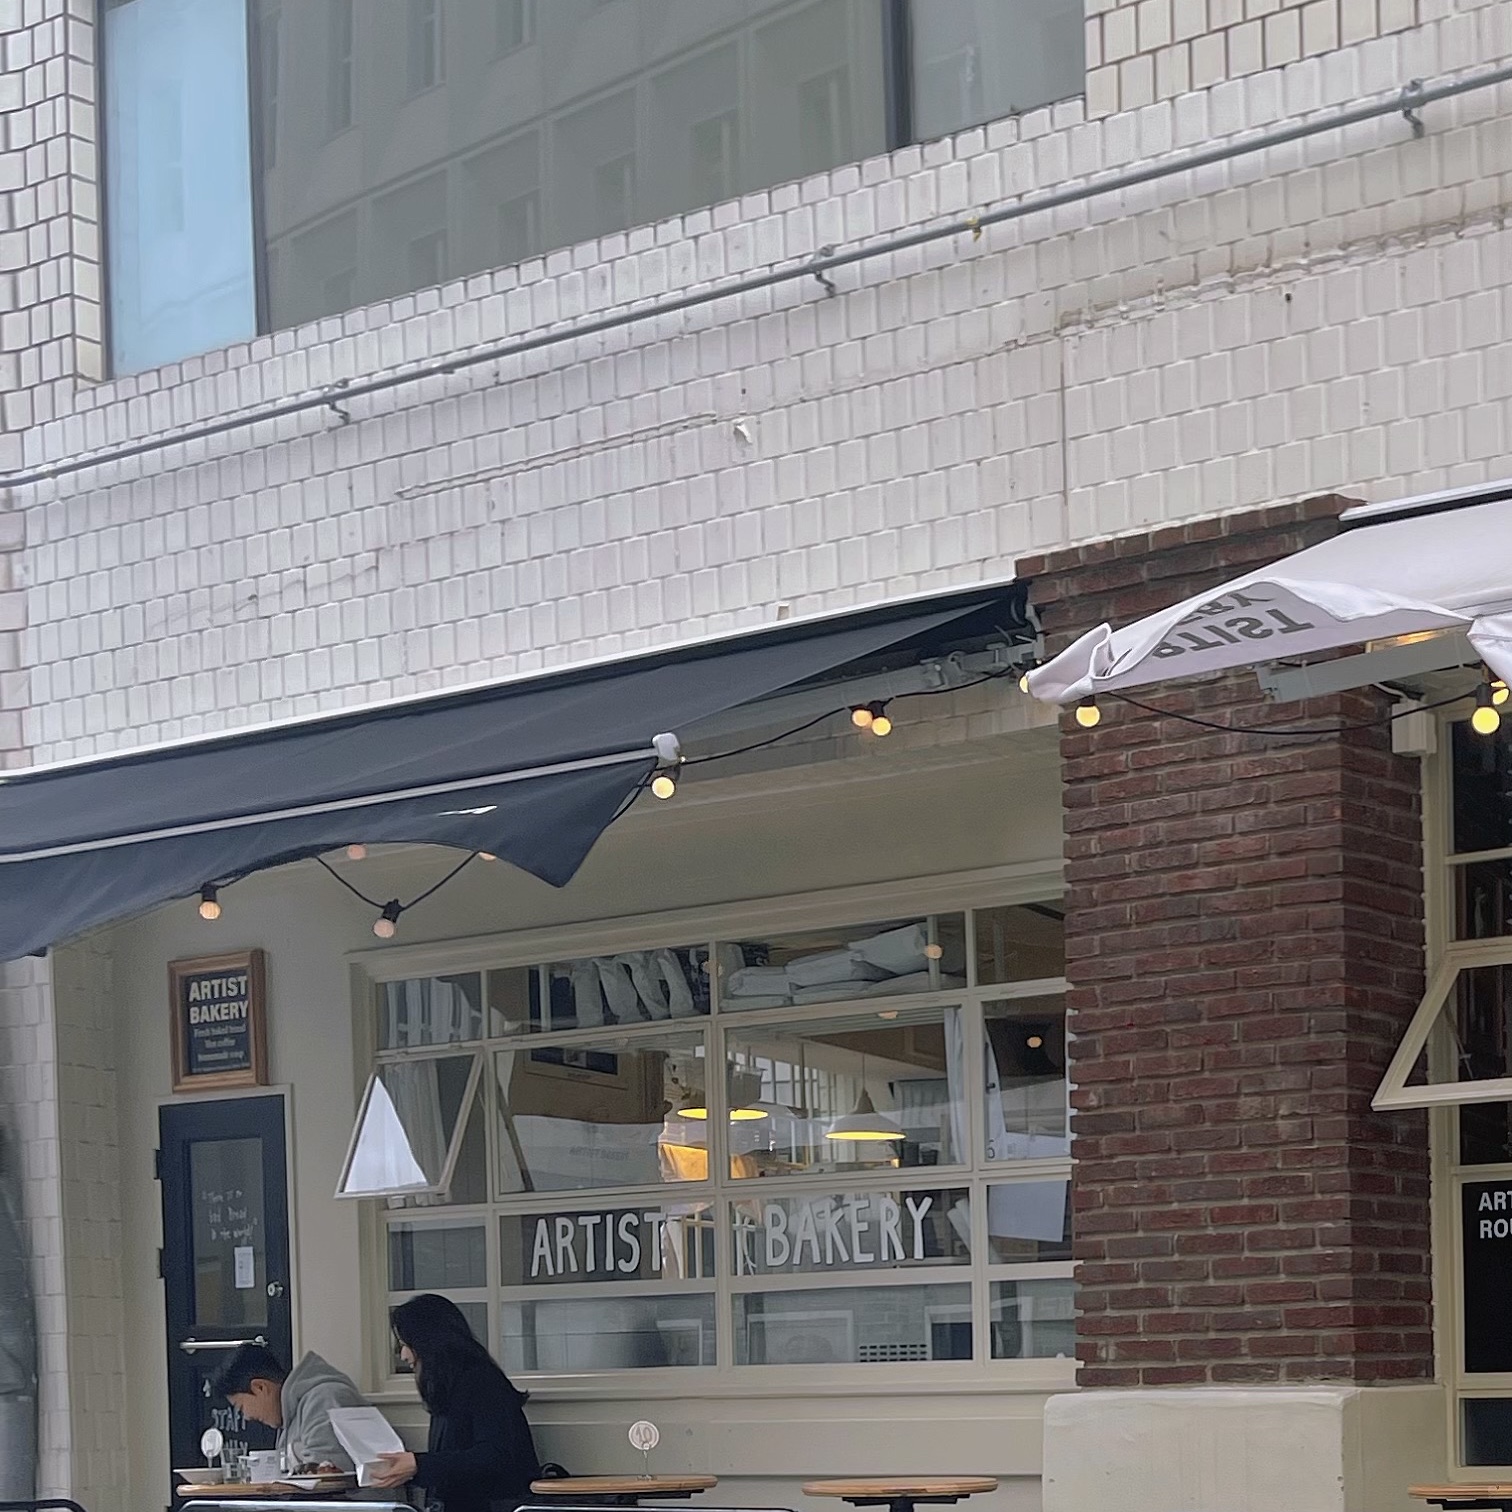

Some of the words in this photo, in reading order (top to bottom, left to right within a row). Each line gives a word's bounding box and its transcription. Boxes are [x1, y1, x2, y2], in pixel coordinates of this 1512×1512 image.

[188, 976, 248, 1002] ARTIST
[189, 1000, 249, 1024] BAKERY
[530, 1211, 667, 1277] ARTIST
[765, 1195, 934, 1267] BAKERY
